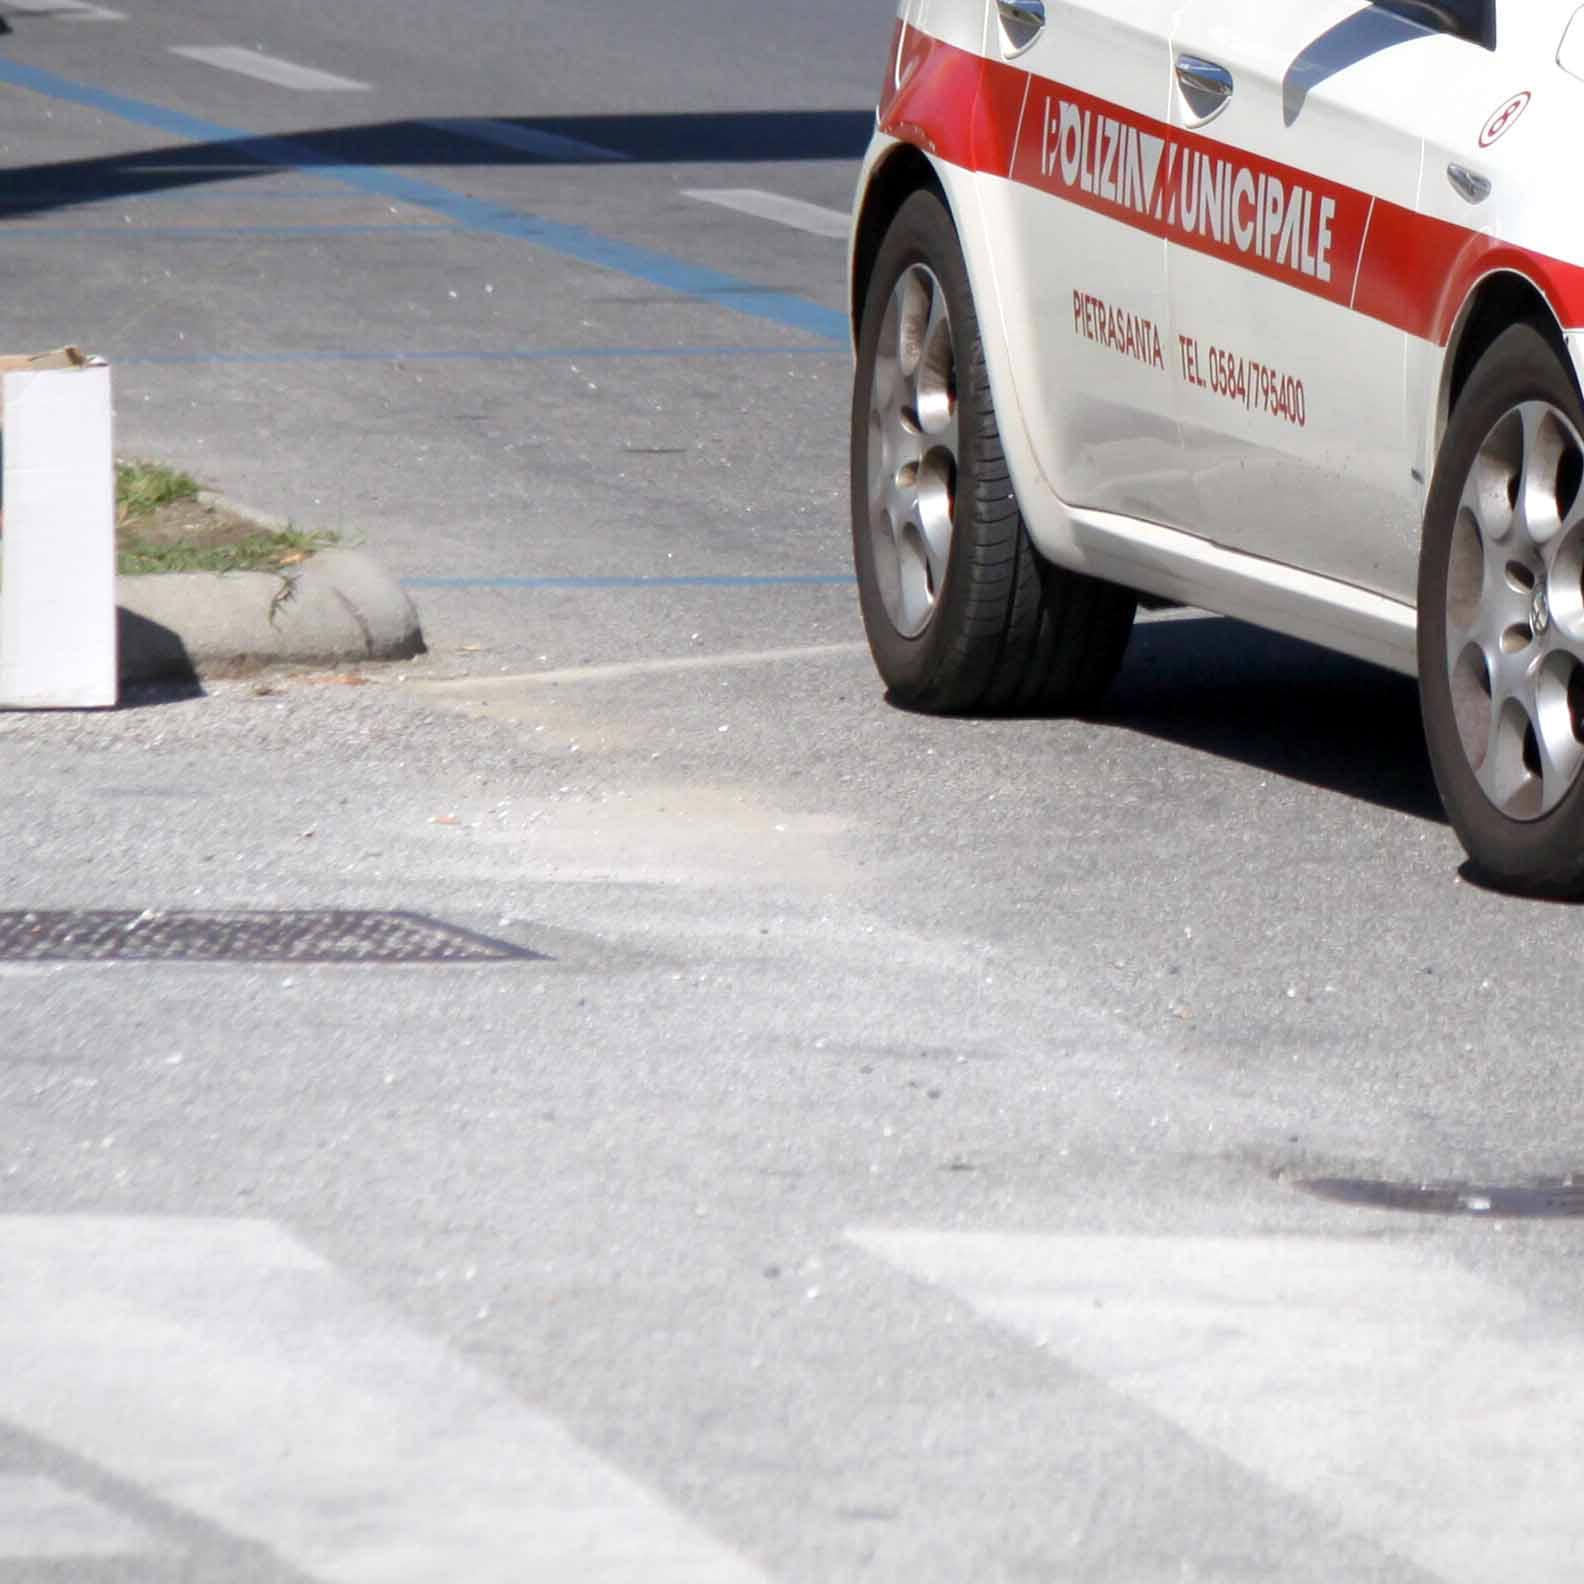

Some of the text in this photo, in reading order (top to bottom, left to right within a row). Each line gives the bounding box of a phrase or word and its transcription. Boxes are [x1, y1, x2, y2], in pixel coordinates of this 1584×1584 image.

[1073, 289, 1306, 428] PIETRASANTA TEL. 0584/795400
